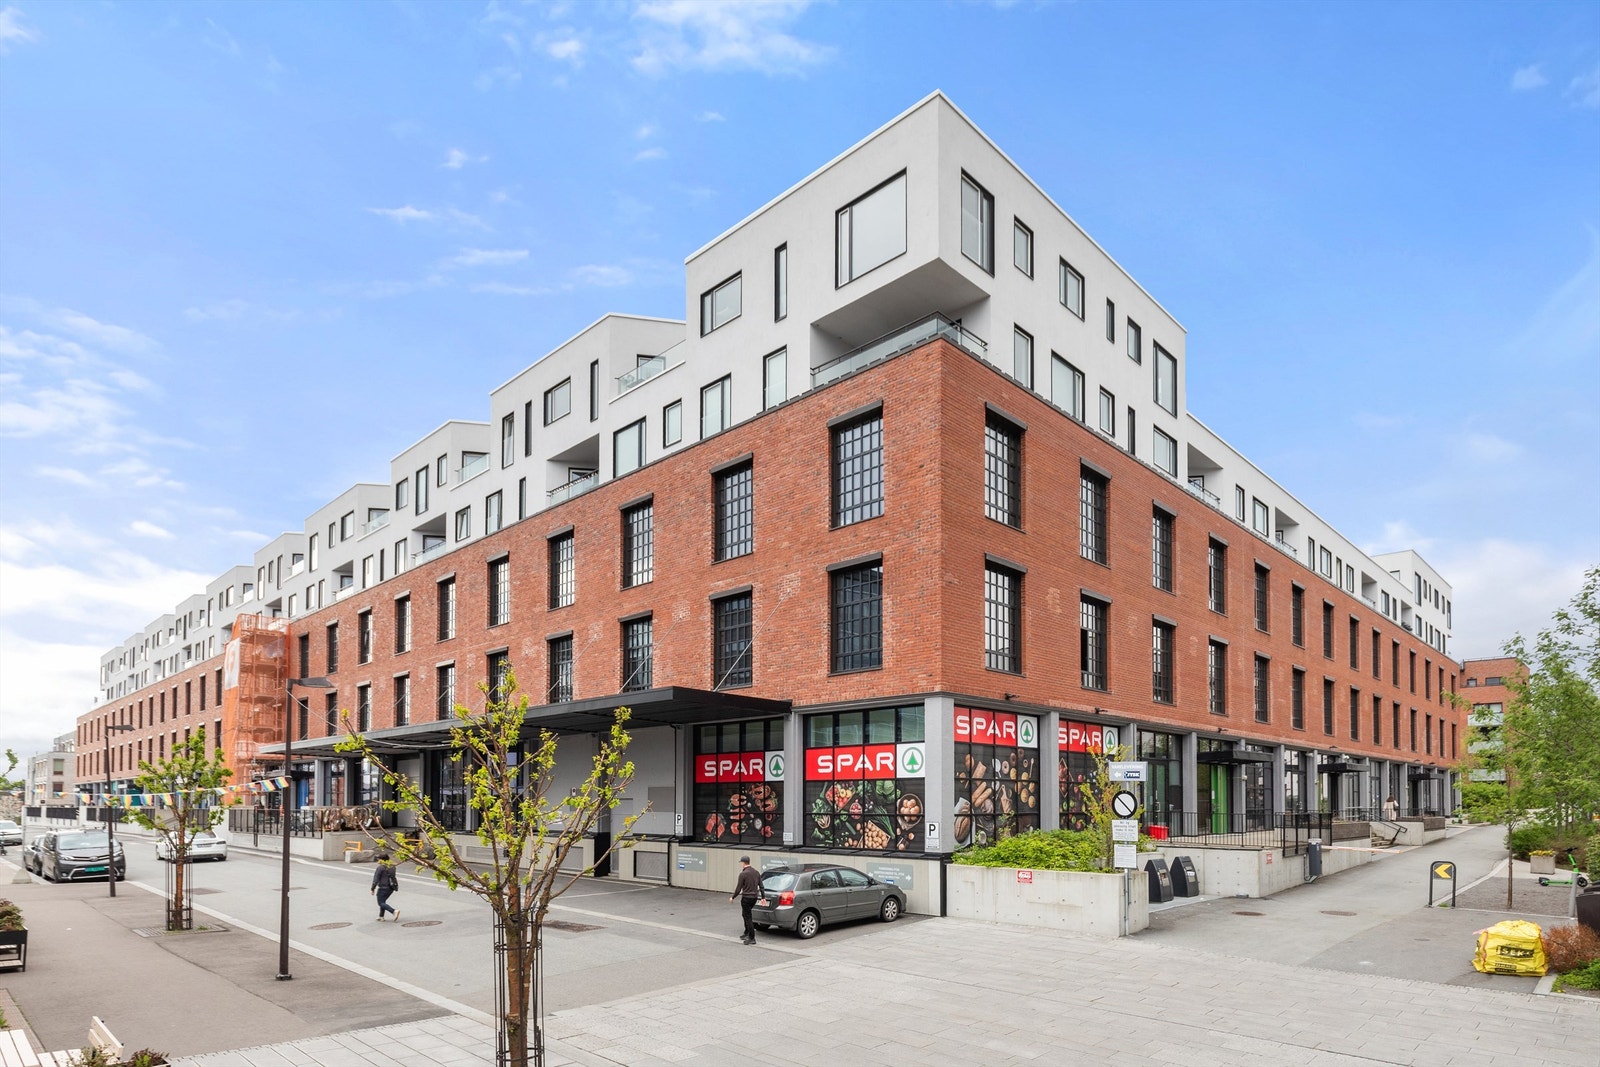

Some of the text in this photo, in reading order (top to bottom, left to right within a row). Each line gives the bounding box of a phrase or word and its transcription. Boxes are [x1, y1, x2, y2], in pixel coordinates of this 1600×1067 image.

[956, 715, 1016, 739] SPAR
[1058, 727, 1102, 747] SPAR
[704, 758, 764, 777] SPAR
[817, 752, 895, 773] SPAR
[677, 814, 682, 825] P
[928, 823, 937, 837] P
